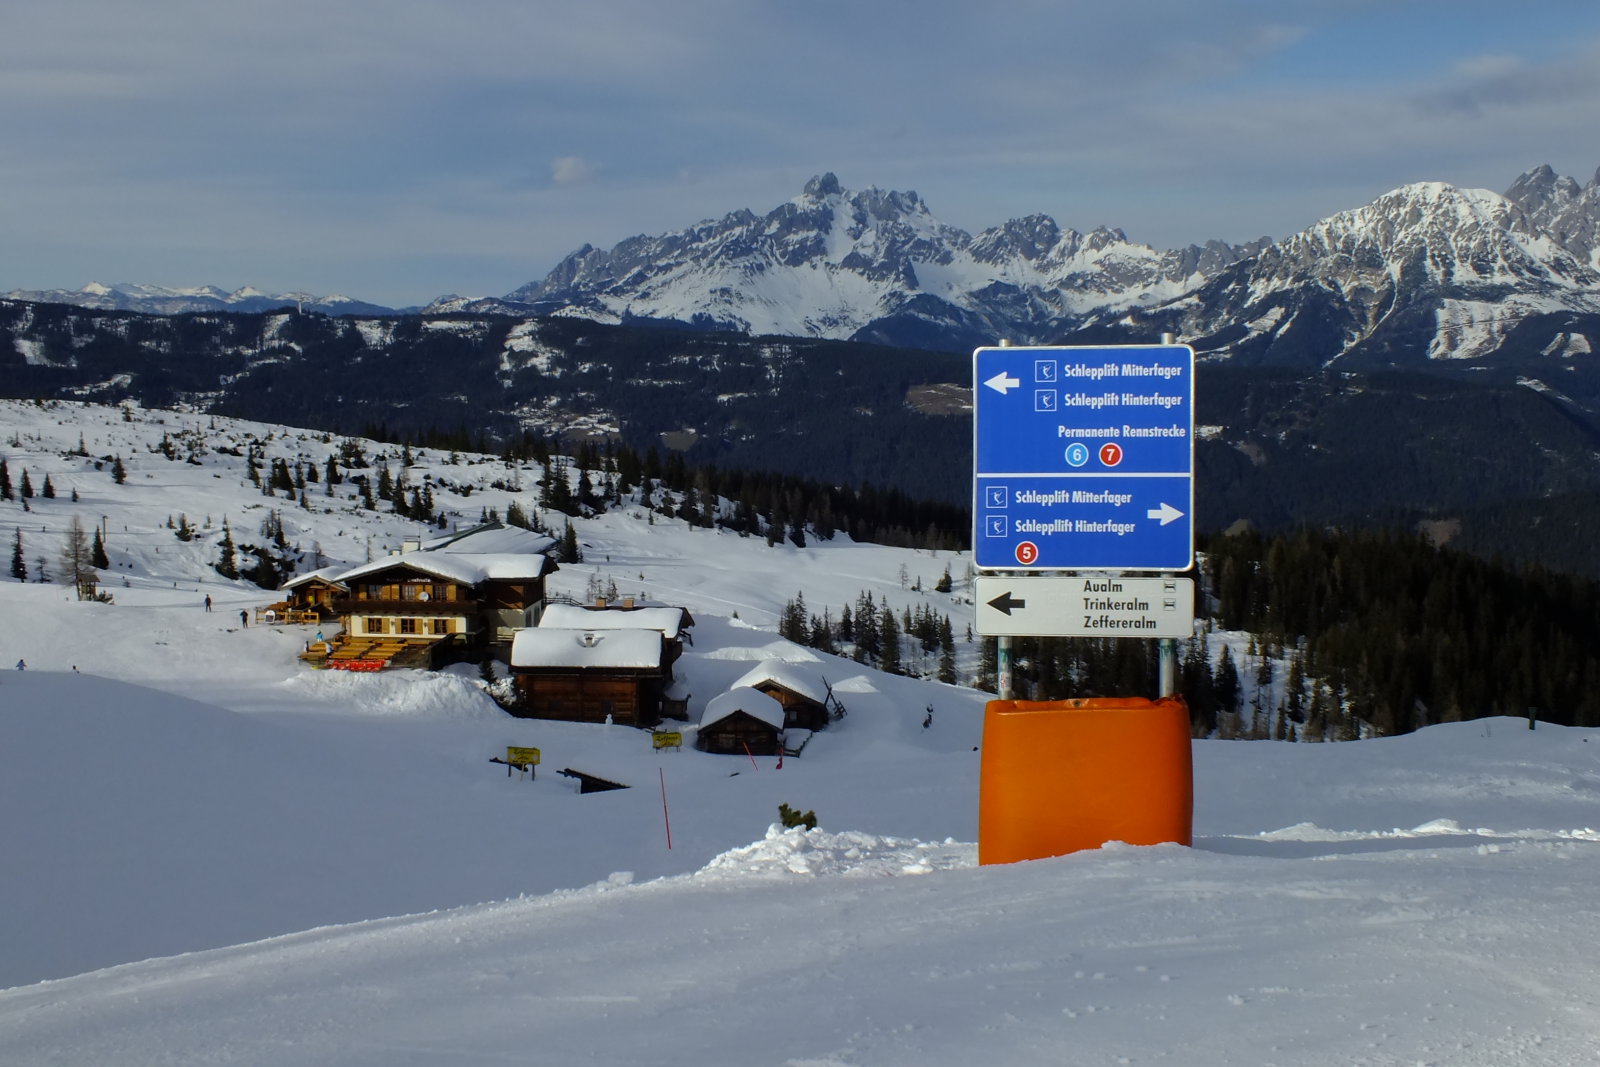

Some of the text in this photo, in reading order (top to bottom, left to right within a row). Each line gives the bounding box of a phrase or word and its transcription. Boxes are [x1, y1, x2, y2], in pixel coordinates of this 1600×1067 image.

[1064, 362, 1183, 380] Schlepplift Mitterfager
[1064, 391, 1183, 409] Schlepplift Hinterfager
[1058, 424, 1186, 438] Permanente Rennstrecke
[1072, 449, 1115, 461] 6 7
[1015, 490, 1132, 507] Schlepplift Mitterfager
[1075, 519, 1136, 536] Hinterfager
[1022, 547, 1031, 559] 5
[1083, 579, 1123, 593] Aualm
[1083, 597, 1149, 611] Trinkeralm
[1083, 615, 1157, 629] Zeffereralm
